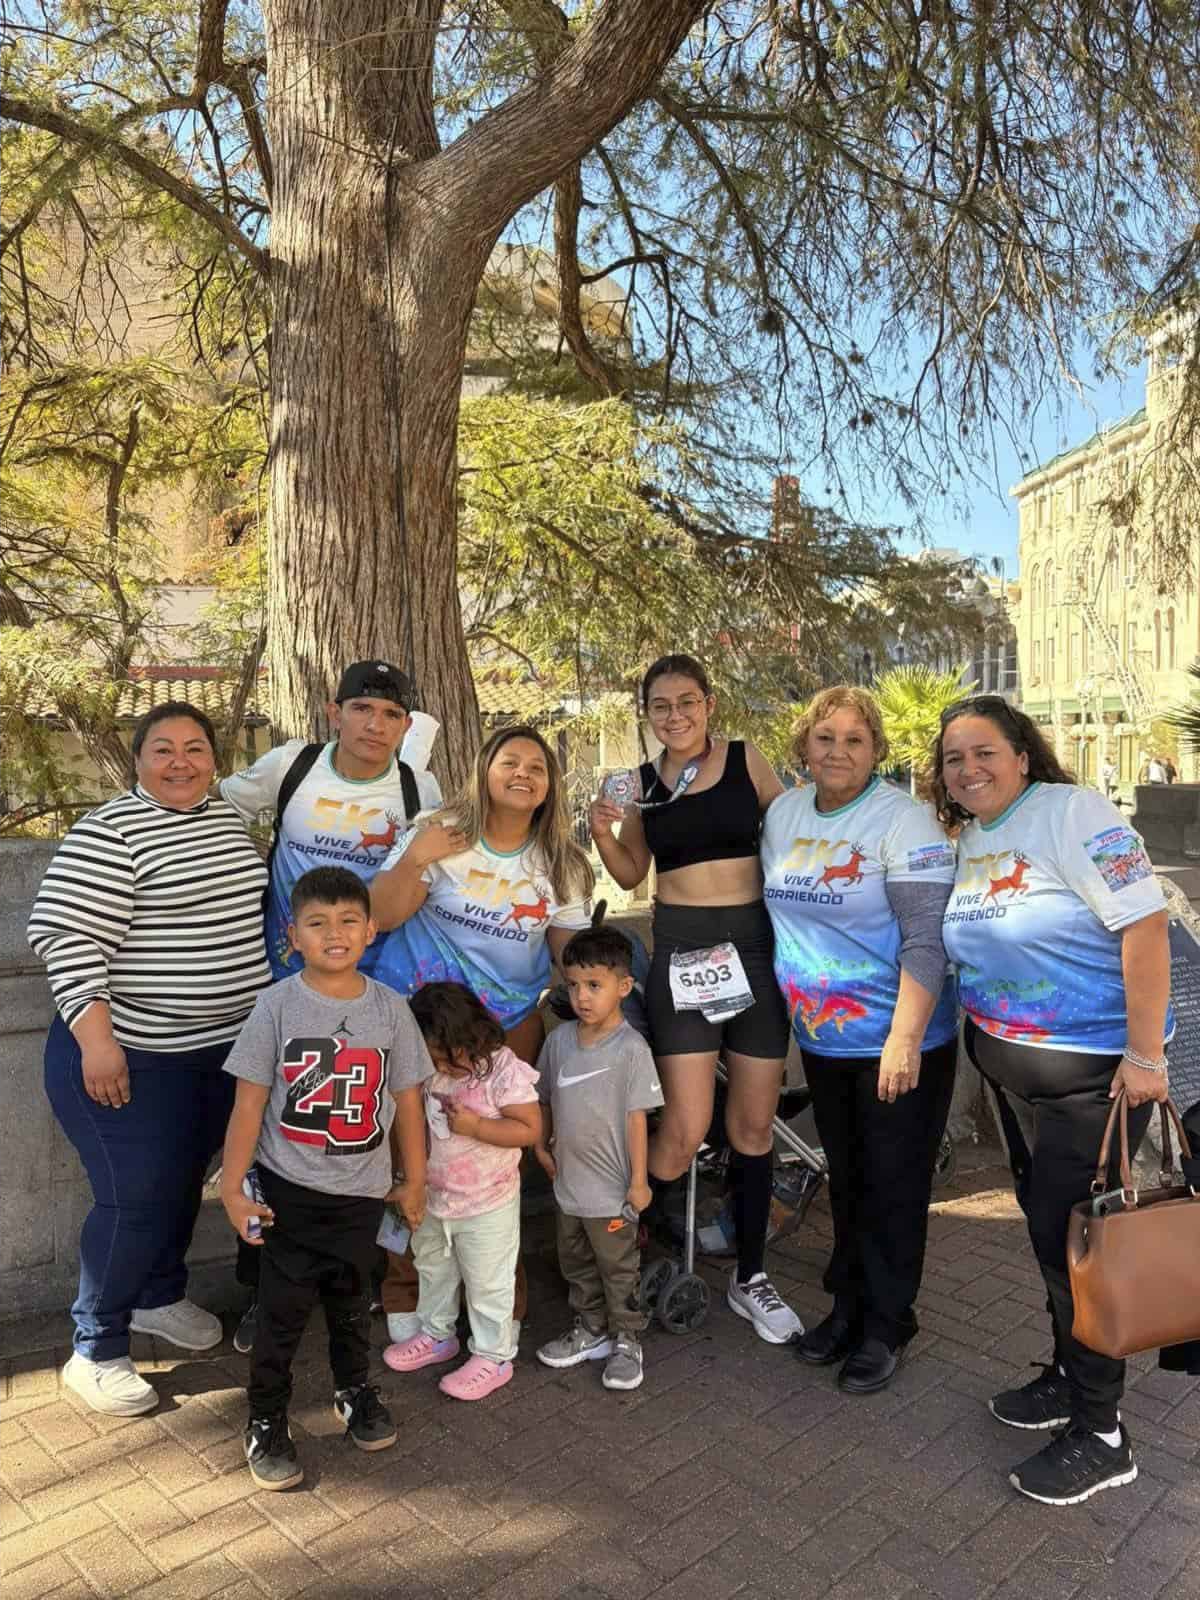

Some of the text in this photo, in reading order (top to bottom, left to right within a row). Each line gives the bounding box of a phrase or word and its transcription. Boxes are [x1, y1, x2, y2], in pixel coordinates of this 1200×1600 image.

[314, 834, 352, 850] VIVE
[287, 840, 378, 866] CORRIENDO
[784, 874, 814, 887] VIVE
[956, 893, 982, 906] VIVE
[464, 902, 504, 922] VIVE
[434, 905, 529, 943] CORRIENDO
[680, 965, 732, 988] 6403
[279, 1038, 390, 1155] 23
